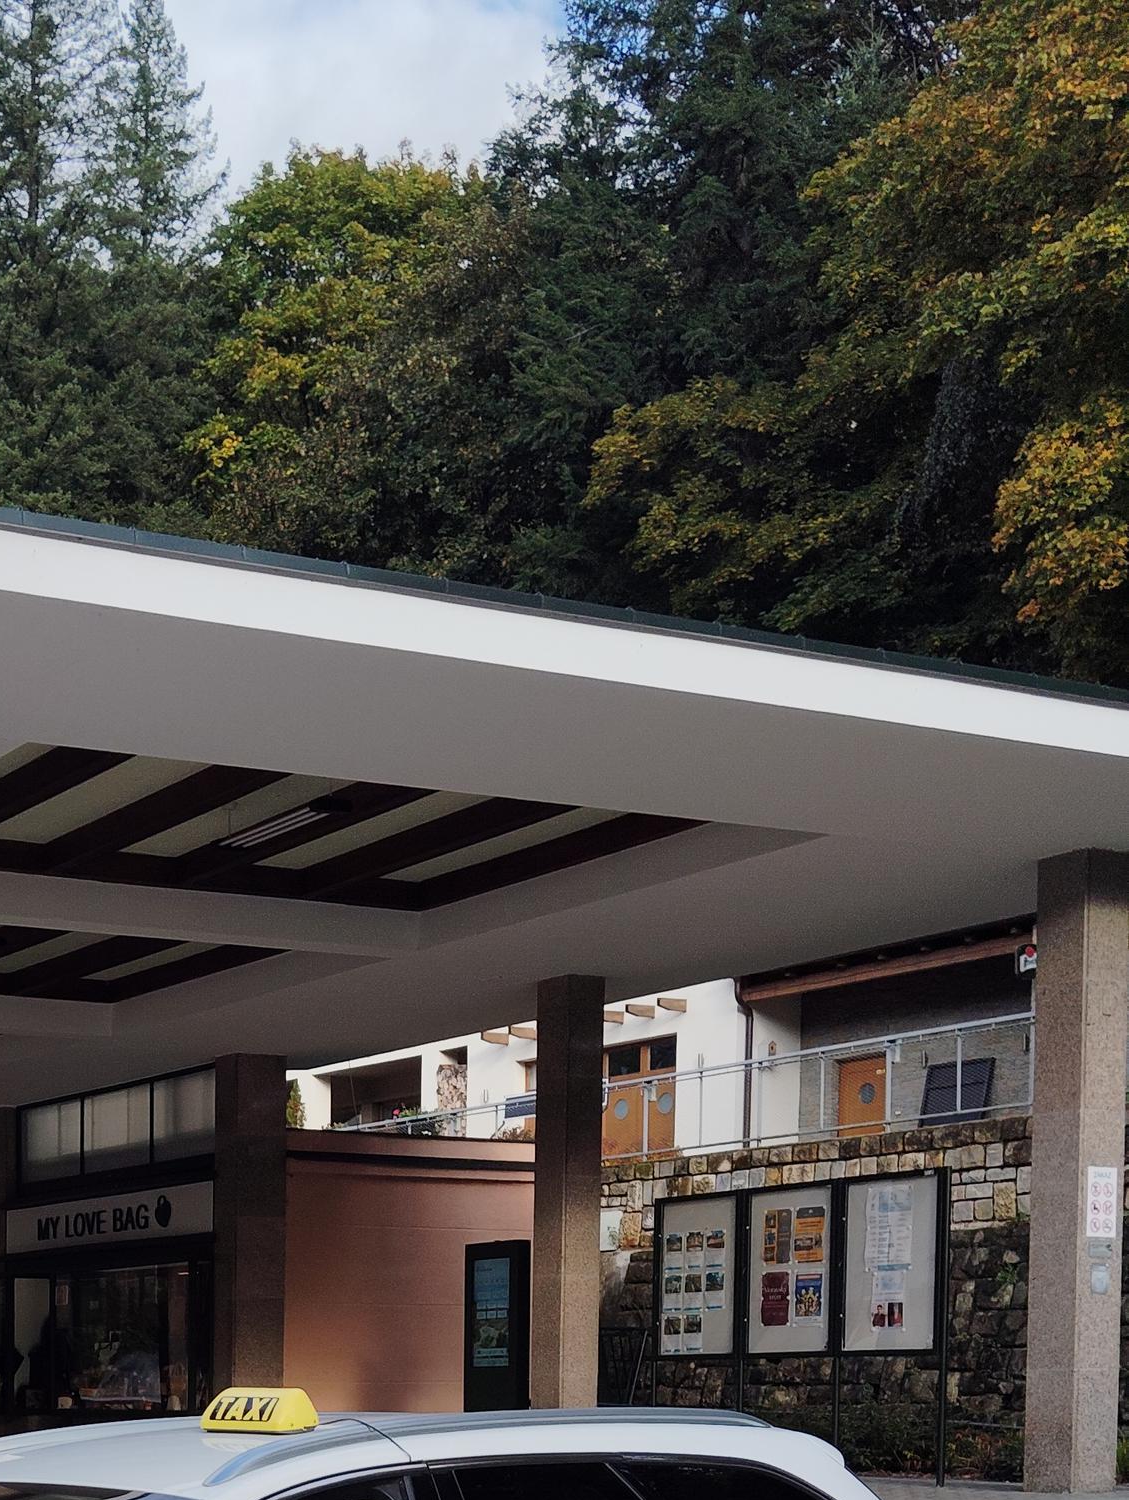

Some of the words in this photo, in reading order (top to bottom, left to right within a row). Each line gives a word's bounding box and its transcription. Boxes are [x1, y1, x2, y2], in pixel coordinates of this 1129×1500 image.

[37, 1215, 60, 1241] MY
[65, 1210, 107, 1237] LOVE
[112, 1204, 149, 1233] BAG
[210, 1397, 279, 1421] TAXI
